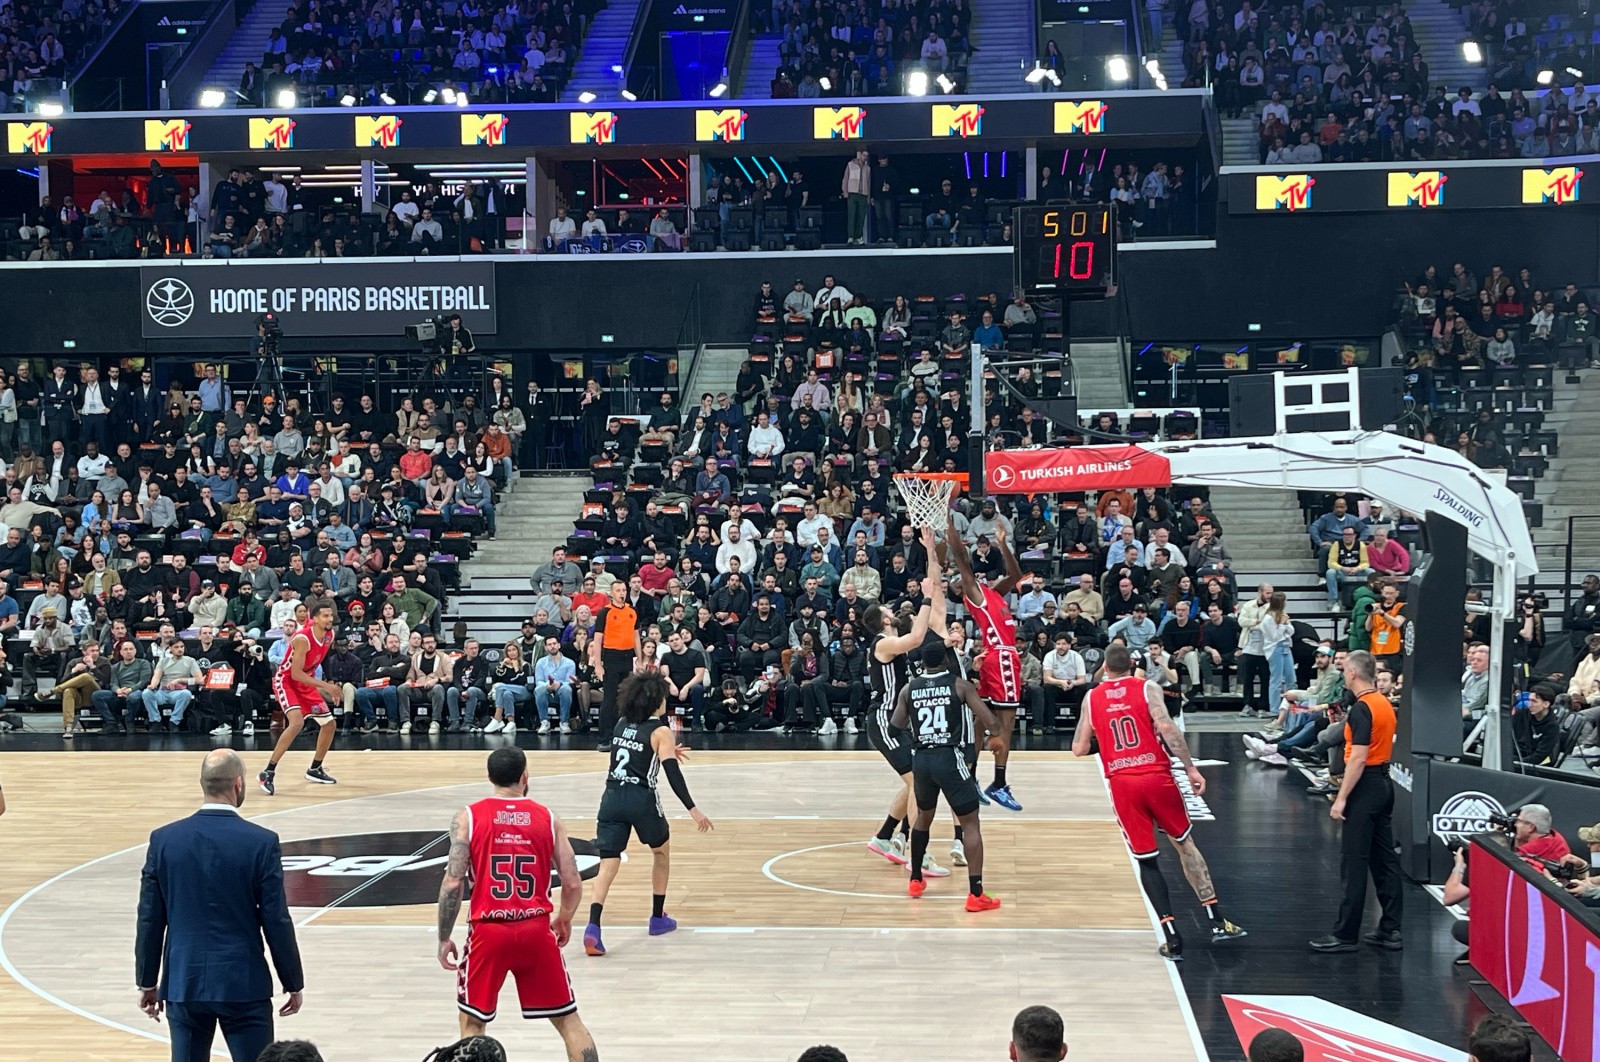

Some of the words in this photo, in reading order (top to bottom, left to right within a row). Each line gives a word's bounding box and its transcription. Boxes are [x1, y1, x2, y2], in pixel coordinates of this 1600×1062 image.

[249, 117, 296, 150] MTV
[356, 116, 402, 148] MTV
[461, 113, 508, 147] MTV
[570, 111, 619, 145] MTV
[695, 109, 748, 143] MTV
[813, 106, 867, 141] MTV
[931, 104, 985, 138] MTV
[1054, 100, 1108, 135] MTV
[8, 122, 53, 155] MTV
[145, 119, 191, 153] MTV
[1256, 173, 1316, 211] MTV
[1387, 170, 1447, 208] MTV
[1522, 166, 1584, 205] MTV
[1054, 241, 1094, 279] 10
[210, 288, 268, 313] HOME
[272, 288, 297, 313] OF
[301, 286, 361, 312] PARIS
[365, 285, 490, 311] BASKETBALL
[1020, 464, 1074, 481] TURKISH
[1076, 459, 1133, 475] AIRLINES
[1433, 488, 1484, 527] SPALDING
[911, 685, 951, 700] OUATTARA
[913, 697, 951, 708] O'TACOS
[917, 705, 948, 736] 24
[1109, 715, 1140, 752] 10
[614, 747, 630, 777] 2
[1107, 753, 1156, 772] MONACO
[493, 810, 532, 826] JAMES
[1438, 818, 1496, 832] O'TACO
[490, 853, 537, 901] 55
